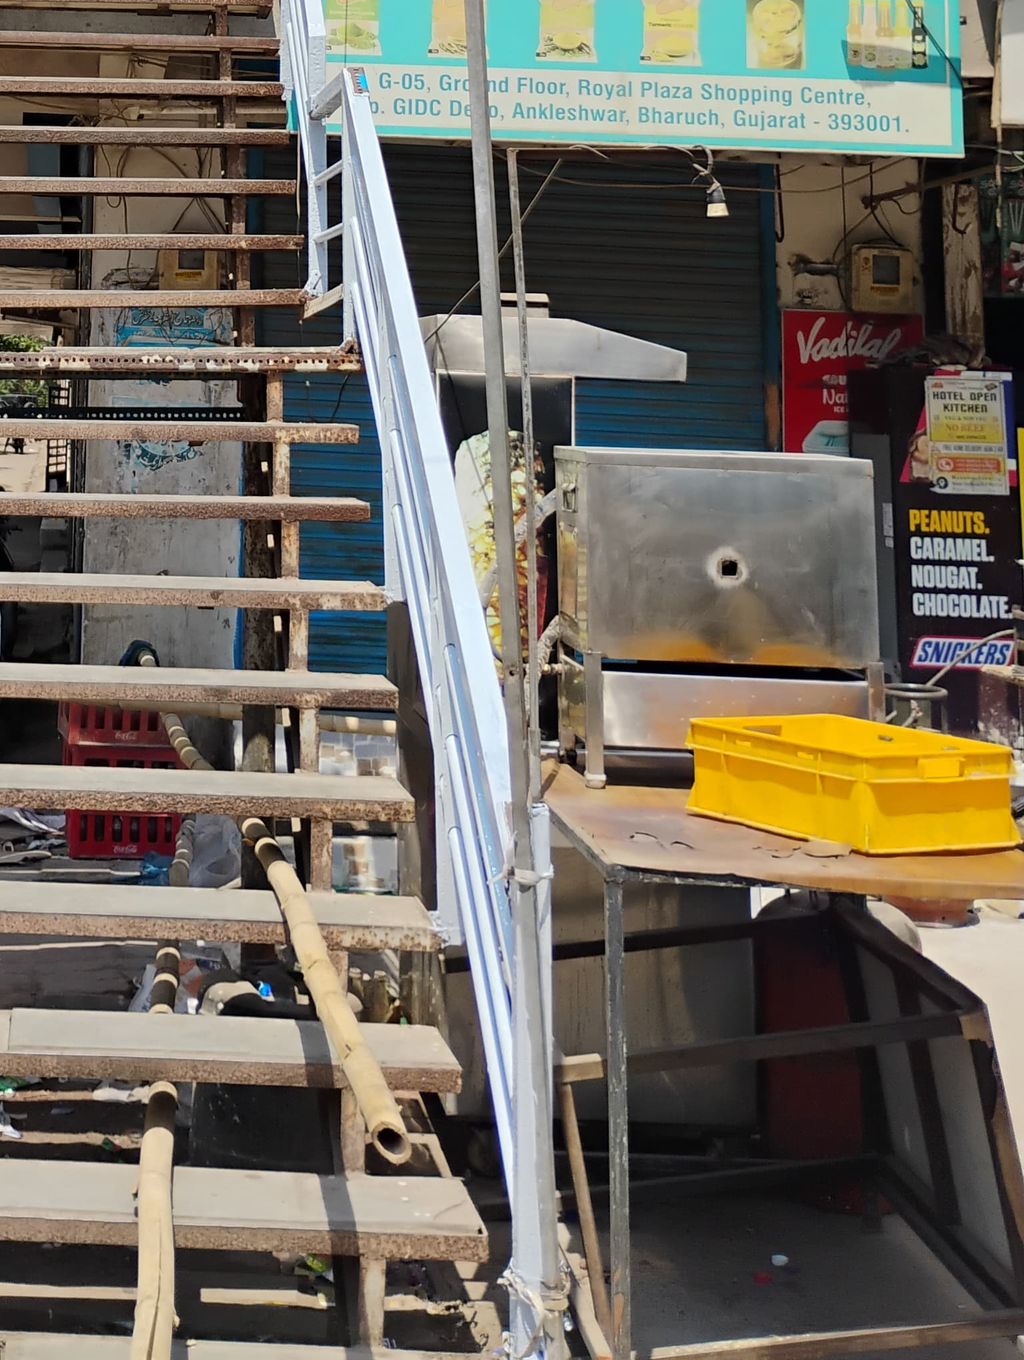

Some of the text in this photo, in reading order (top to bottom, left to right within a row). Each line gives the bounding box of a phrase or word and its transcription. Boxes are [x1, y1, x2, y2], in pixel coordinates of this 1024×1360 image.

[378, 72, 871, 108] G-05, Grond Floor, Royal Plaza Shopping Centre,
[393, 98, 441, 117] GIDC
[450, 100, 504, 120] Deo,
[512, 102, 630, 125] Ankleshwar,
[638, 106, 725, 129] Bharuch,
[733, 109, 806, 132] Gujarat
[828, 113, 910, 133] 393001.
[796, 316, 901, 364] Vadilal
[932, 391, 996, 402] HOTEL OPEN
[943, 403, 988, 413] KITCHEN
[909, 508, 990, 534] PEANUTS.
[910, 536, 995, 562] CARAMEL.
[911, 564, 983, 590] NOUGAT.
[912, 592, 1013, 620] CHOCOLATE.
[917, 640, 1012, 666] SNICKERS
